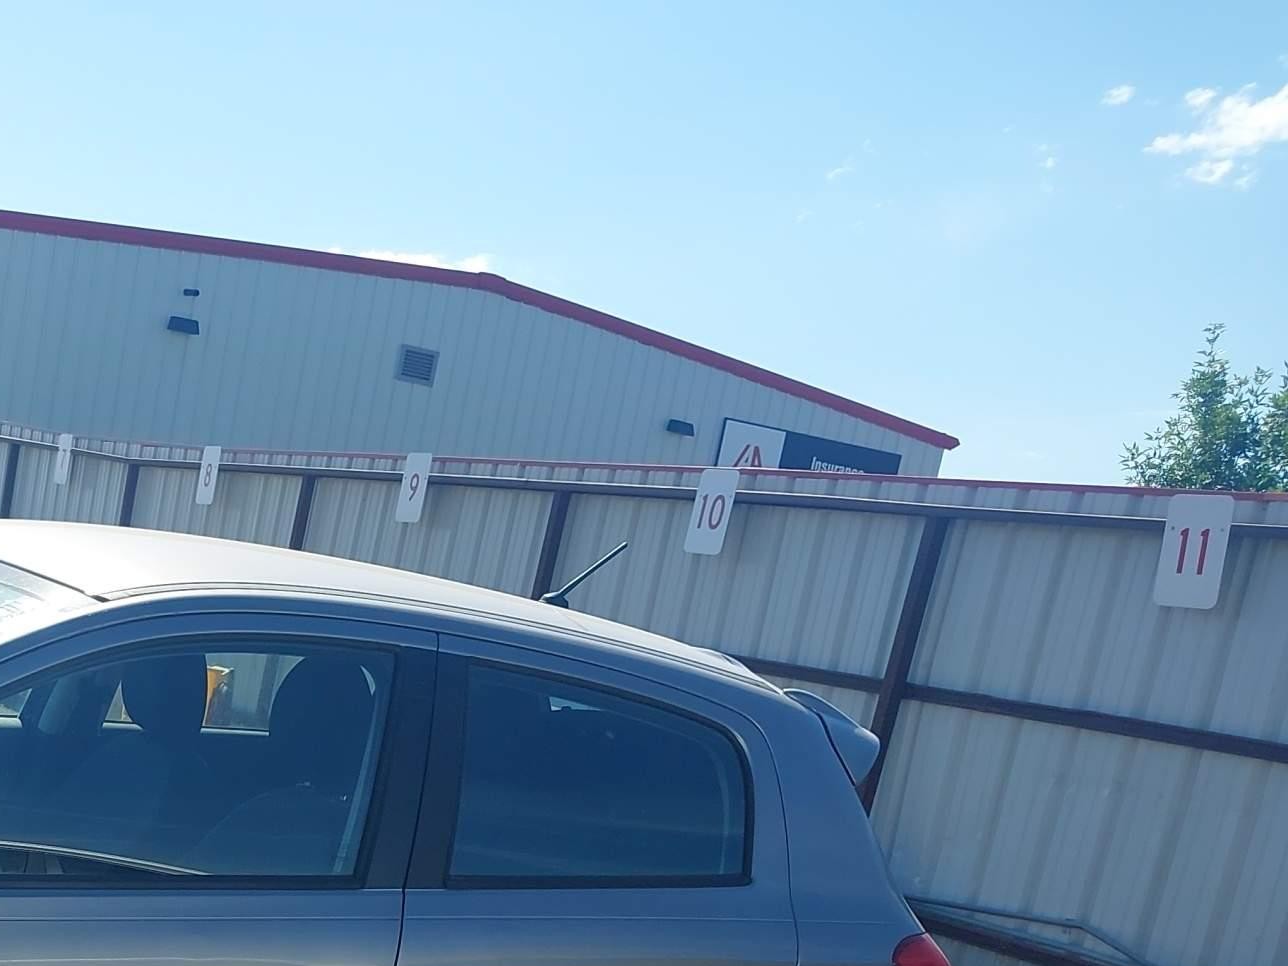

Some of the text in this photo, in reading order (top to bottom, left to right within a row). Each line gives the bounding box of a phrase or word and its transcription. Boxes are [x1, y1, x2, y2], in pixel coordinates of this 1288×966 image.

[203, 463, 212, 487] 8
[409, 473, 420, 501] 9
[697, 494, 726, 530] 10
[1176, 527, 1210, 575] 11
